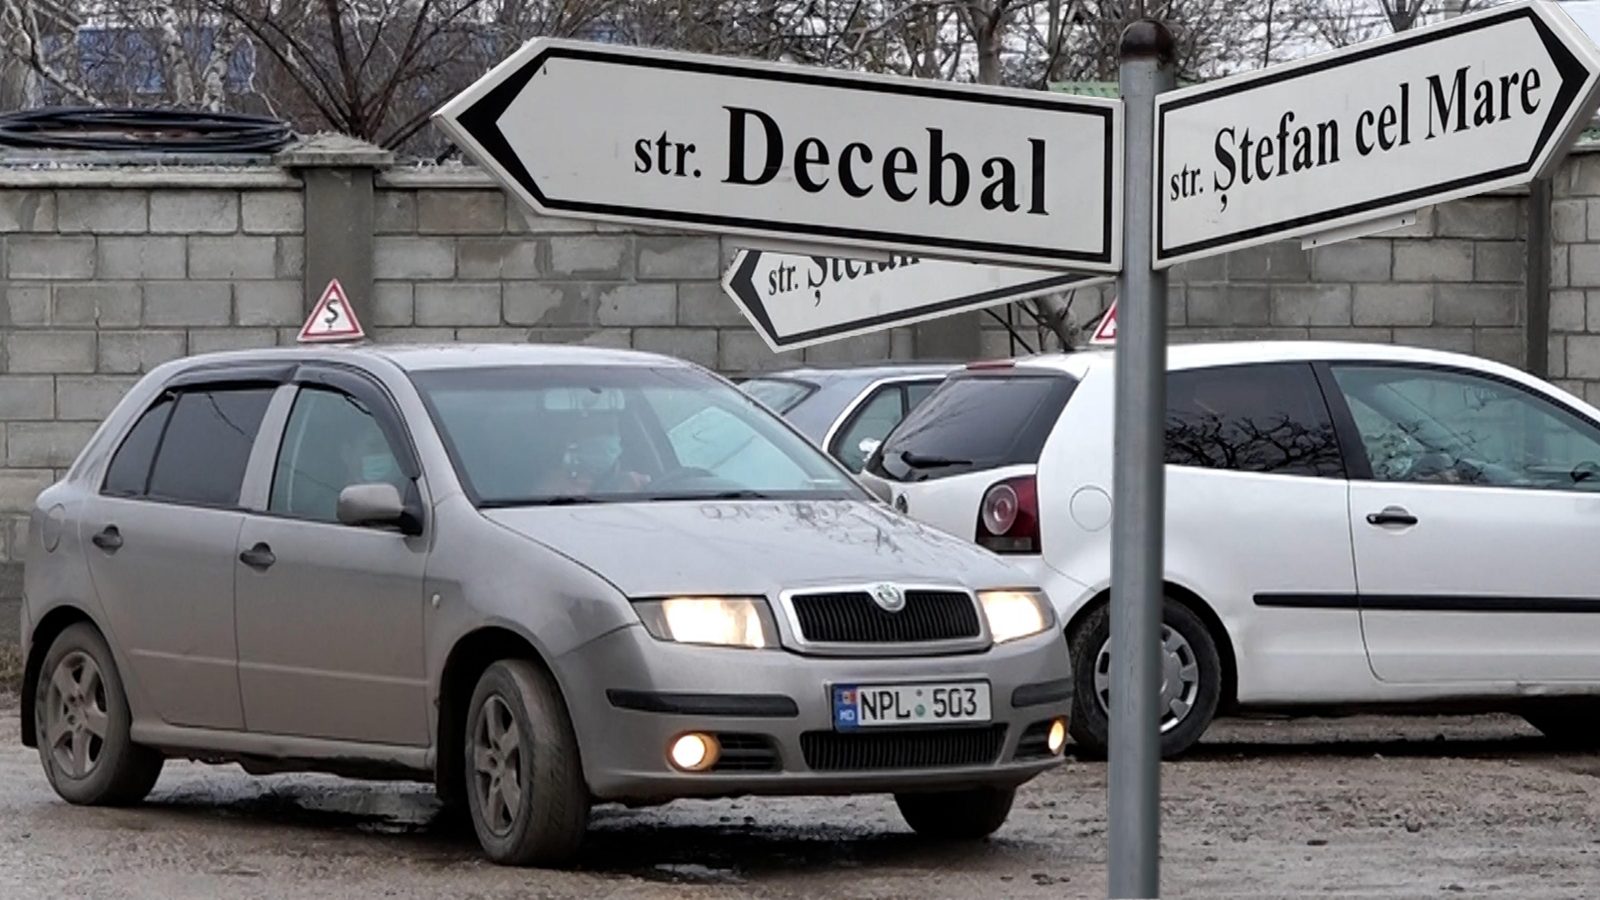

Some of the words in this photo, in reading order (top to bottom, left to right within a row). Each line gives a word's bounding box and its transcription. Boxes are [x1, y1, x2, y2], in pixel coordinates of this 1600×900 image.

[634, 130, 703, 179] str.
[721, 105, 1049, 216] Decebal
[1170, 163, 1204, 202] str.
[1213, 111, 1340, 214] Ștefan
[1355, 82, 1411, 157] cel
[1425, 65, 1542, 141] Mare
[768, 260, 799, 296] str.
[860, 690, 911, 721] NPL
[933, 687, 977, 718] 503
